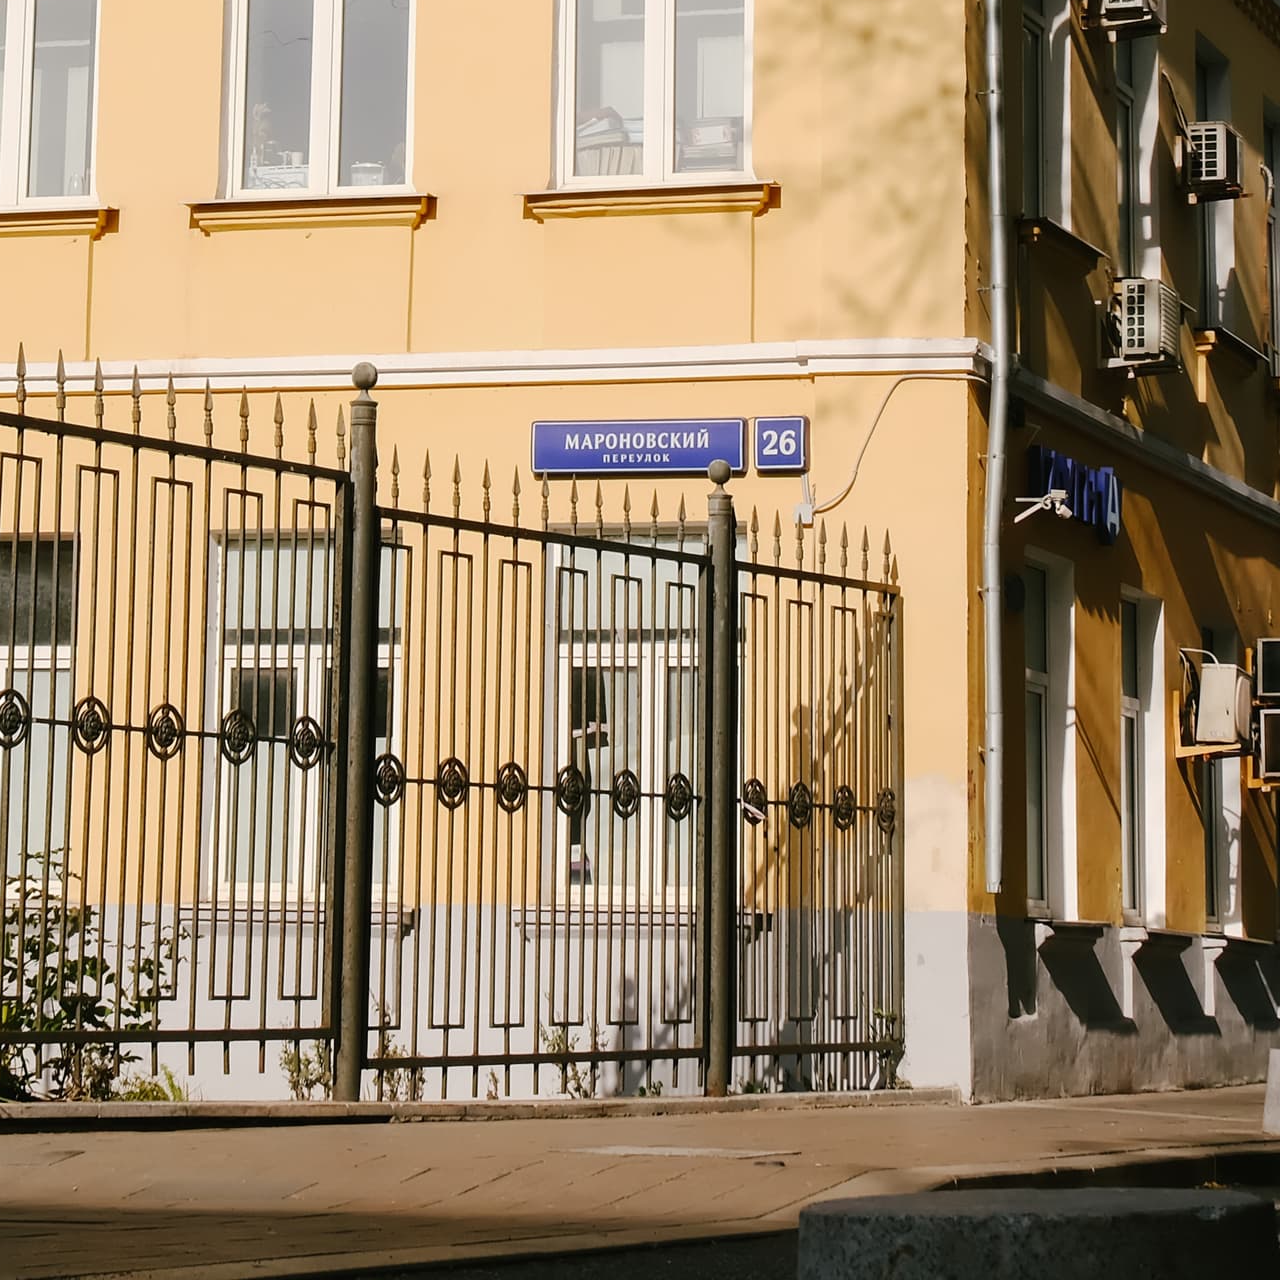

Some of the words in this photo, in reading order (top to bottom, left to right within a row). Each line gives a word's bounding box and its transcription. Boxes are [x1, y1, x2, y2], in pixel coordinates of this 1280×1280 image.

[564, 428, 710, 451] МАРОНОВСКИЙ
[761, 429, 797, 456] 26
[602, 453, 671, 464] ПЕРЕУЛОК
